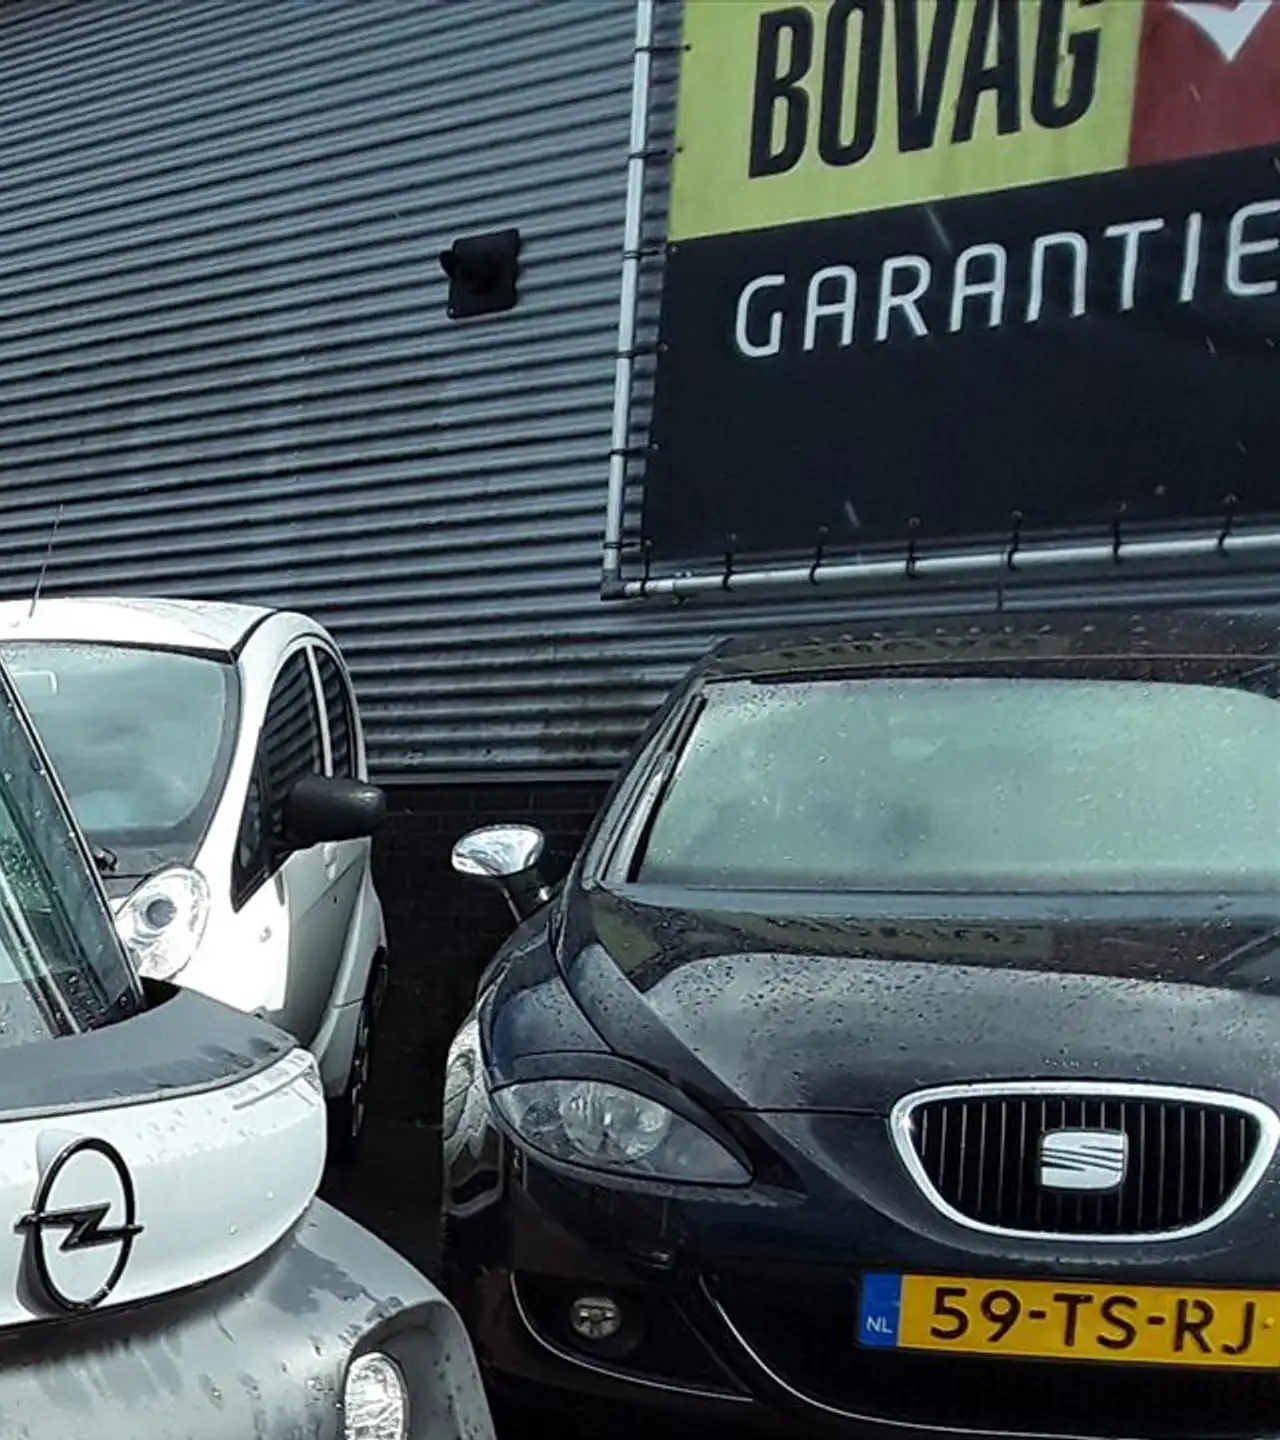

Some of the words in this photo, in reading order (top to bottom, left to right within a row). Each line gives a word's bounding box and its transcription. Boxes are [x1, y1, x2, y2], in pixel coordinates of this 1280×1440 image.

[748, 0, 1104, 179] BOVAG
[736, 199, 1280, 357] GARANTIE
[866, 1315, 893, 1334] NL
[930, 1286, 1256, 1356] 59-TS-RJ
